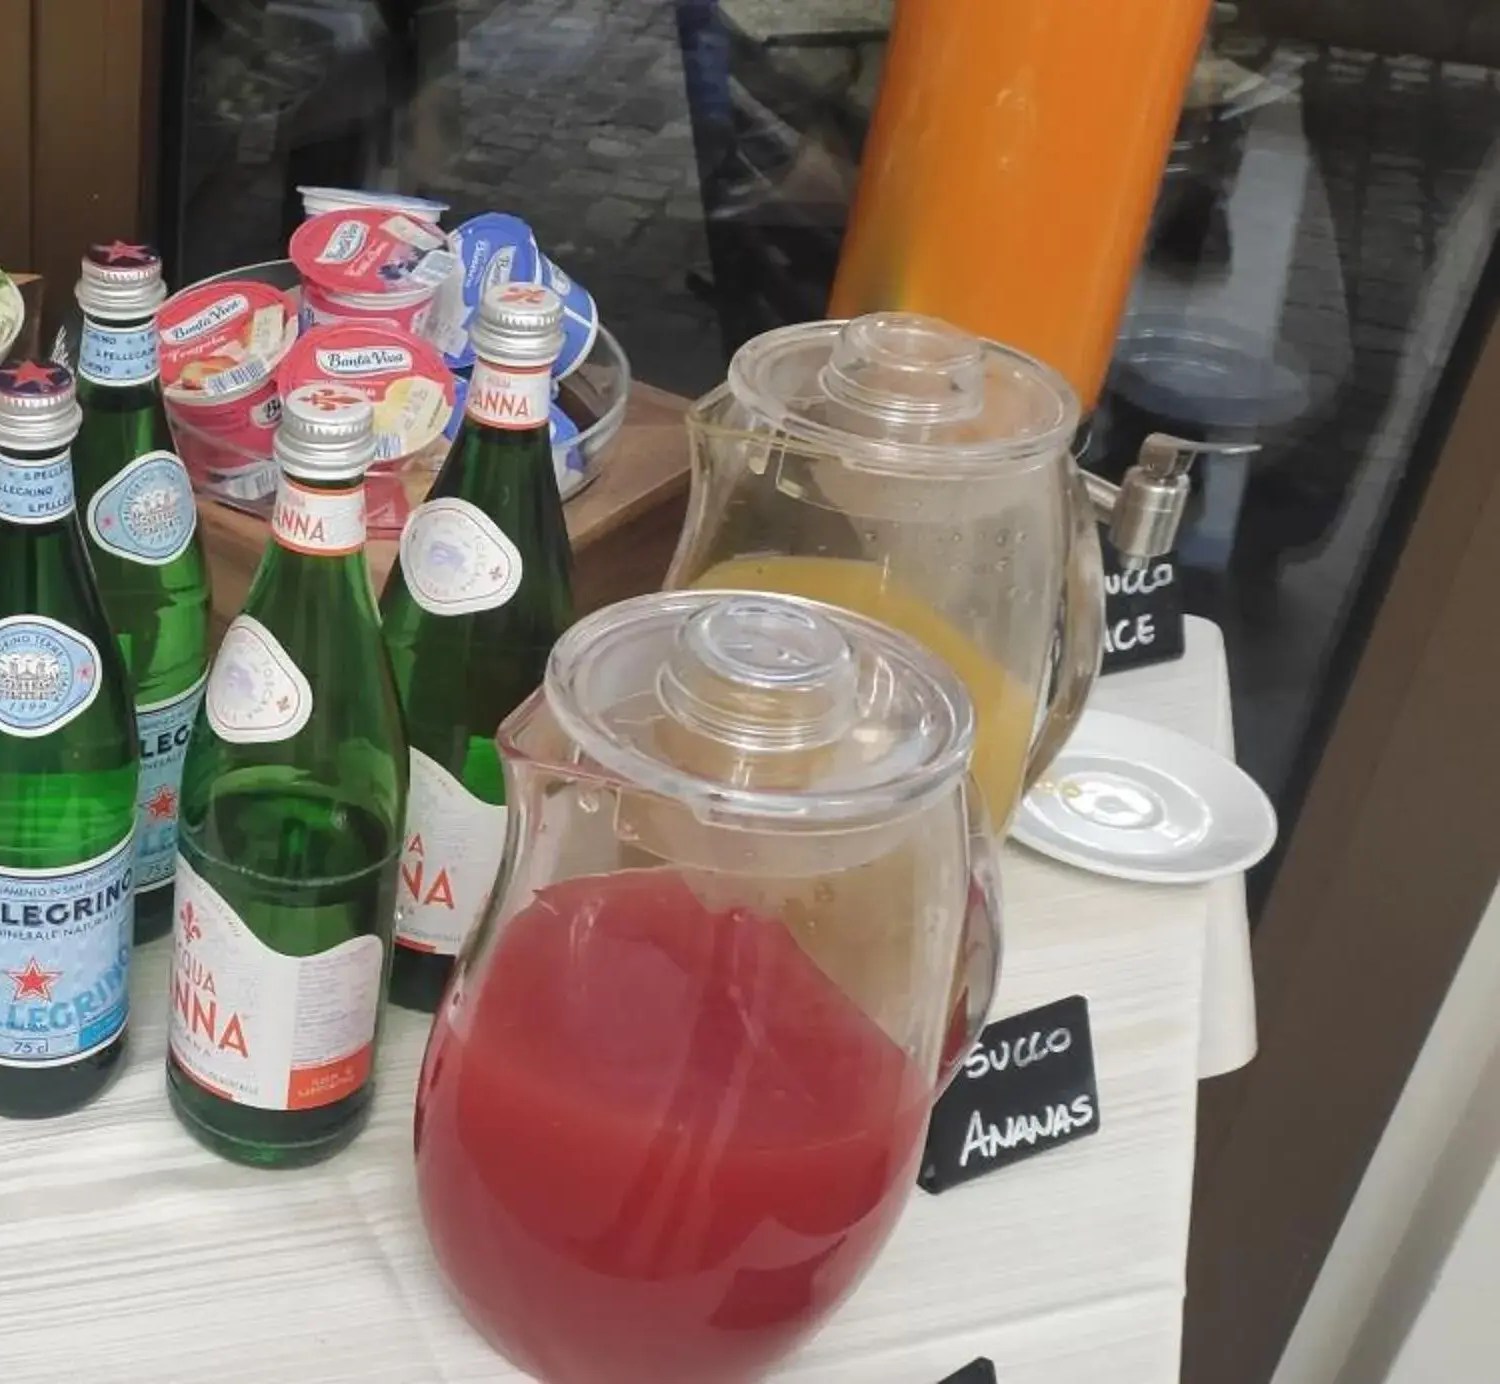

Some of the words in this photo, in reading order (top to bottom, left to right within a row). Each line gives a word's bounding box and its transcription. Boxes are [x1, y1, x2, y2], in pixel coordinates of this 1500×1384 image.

[472, 388, 530, 418] ANNA
[1103, 562, 1174, 595] UCCO
[12, 1040, 34, 1054] 75
[963, 1027, 1073, 1079] SUCCO
[959, 1093, 1094, 1167] ANANAS
